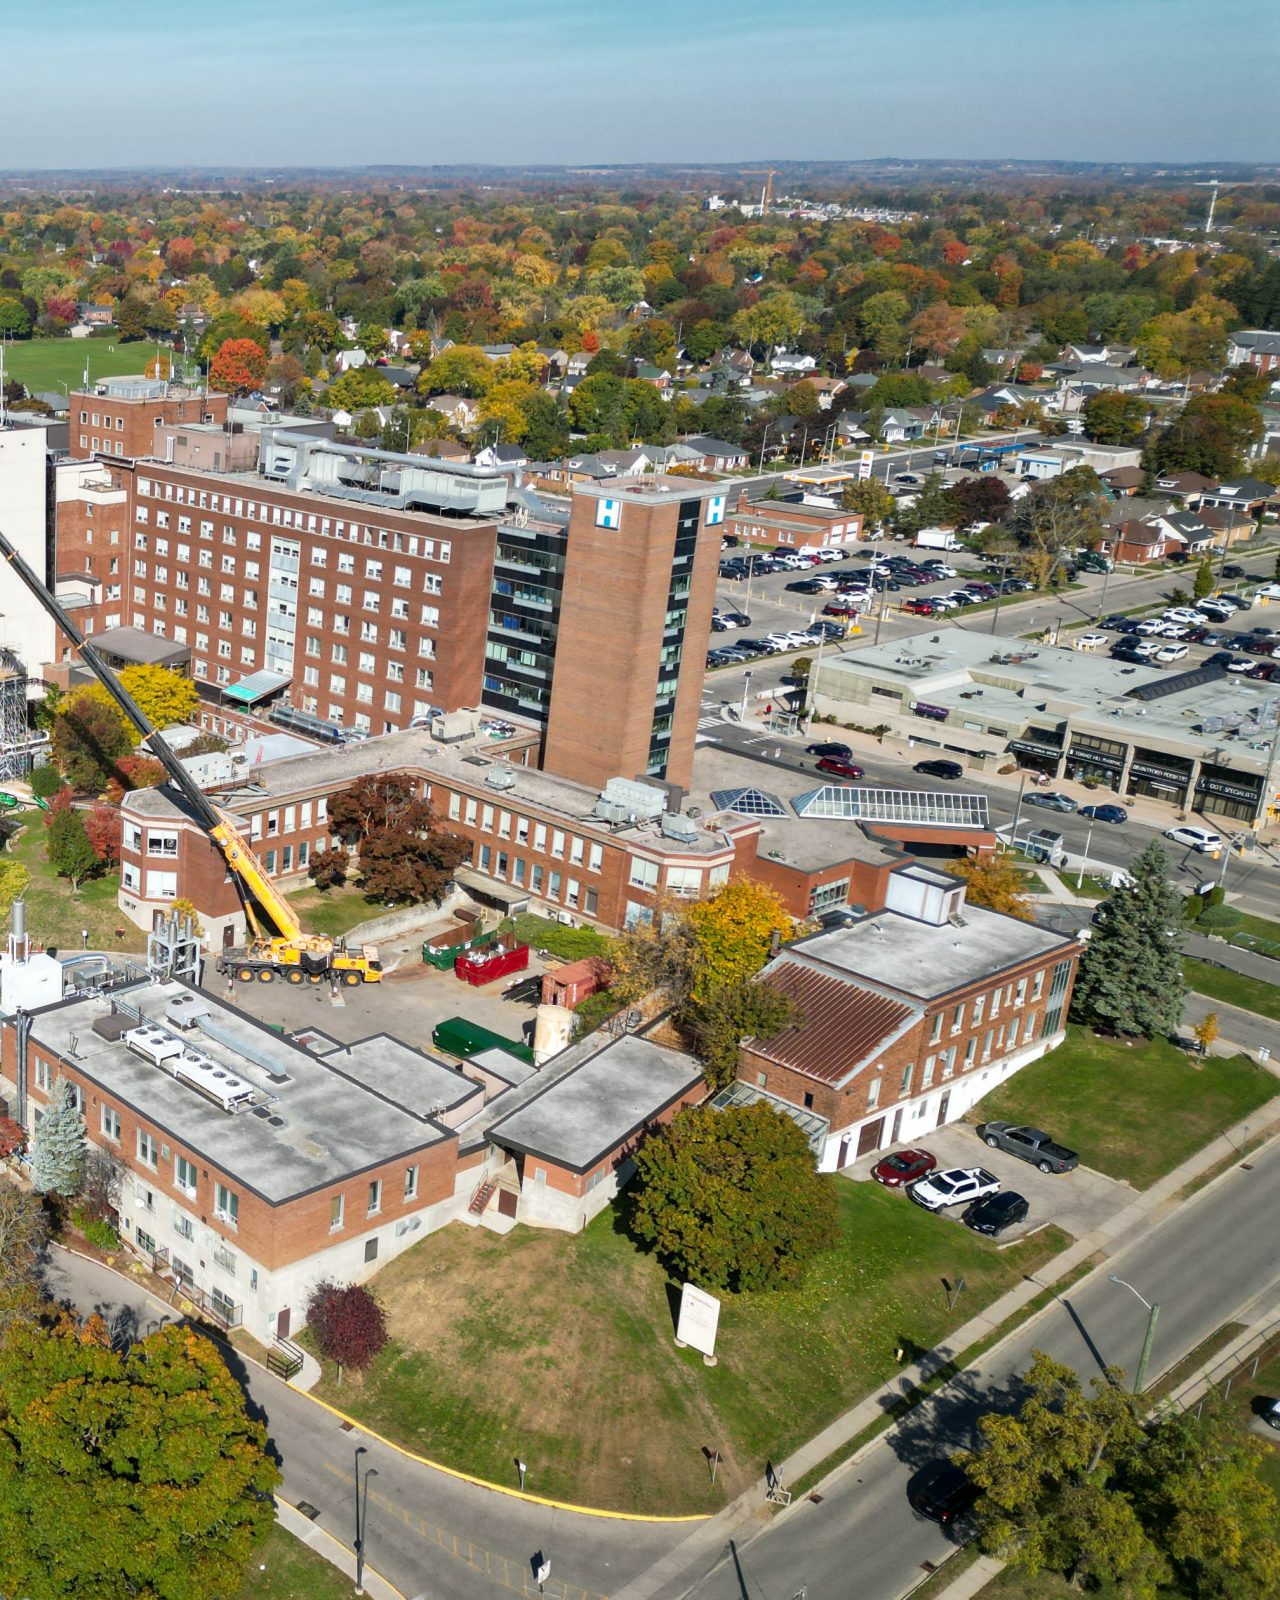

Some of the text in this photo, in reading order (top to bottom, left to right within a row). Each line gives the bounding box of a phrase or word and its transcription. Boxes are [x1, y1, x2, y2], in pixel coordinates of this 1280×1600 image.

[596, 499, 620, 528] H
[707, 496, 726, 524] H
[1224, 786, 1258, 799] SPECIALISTS
